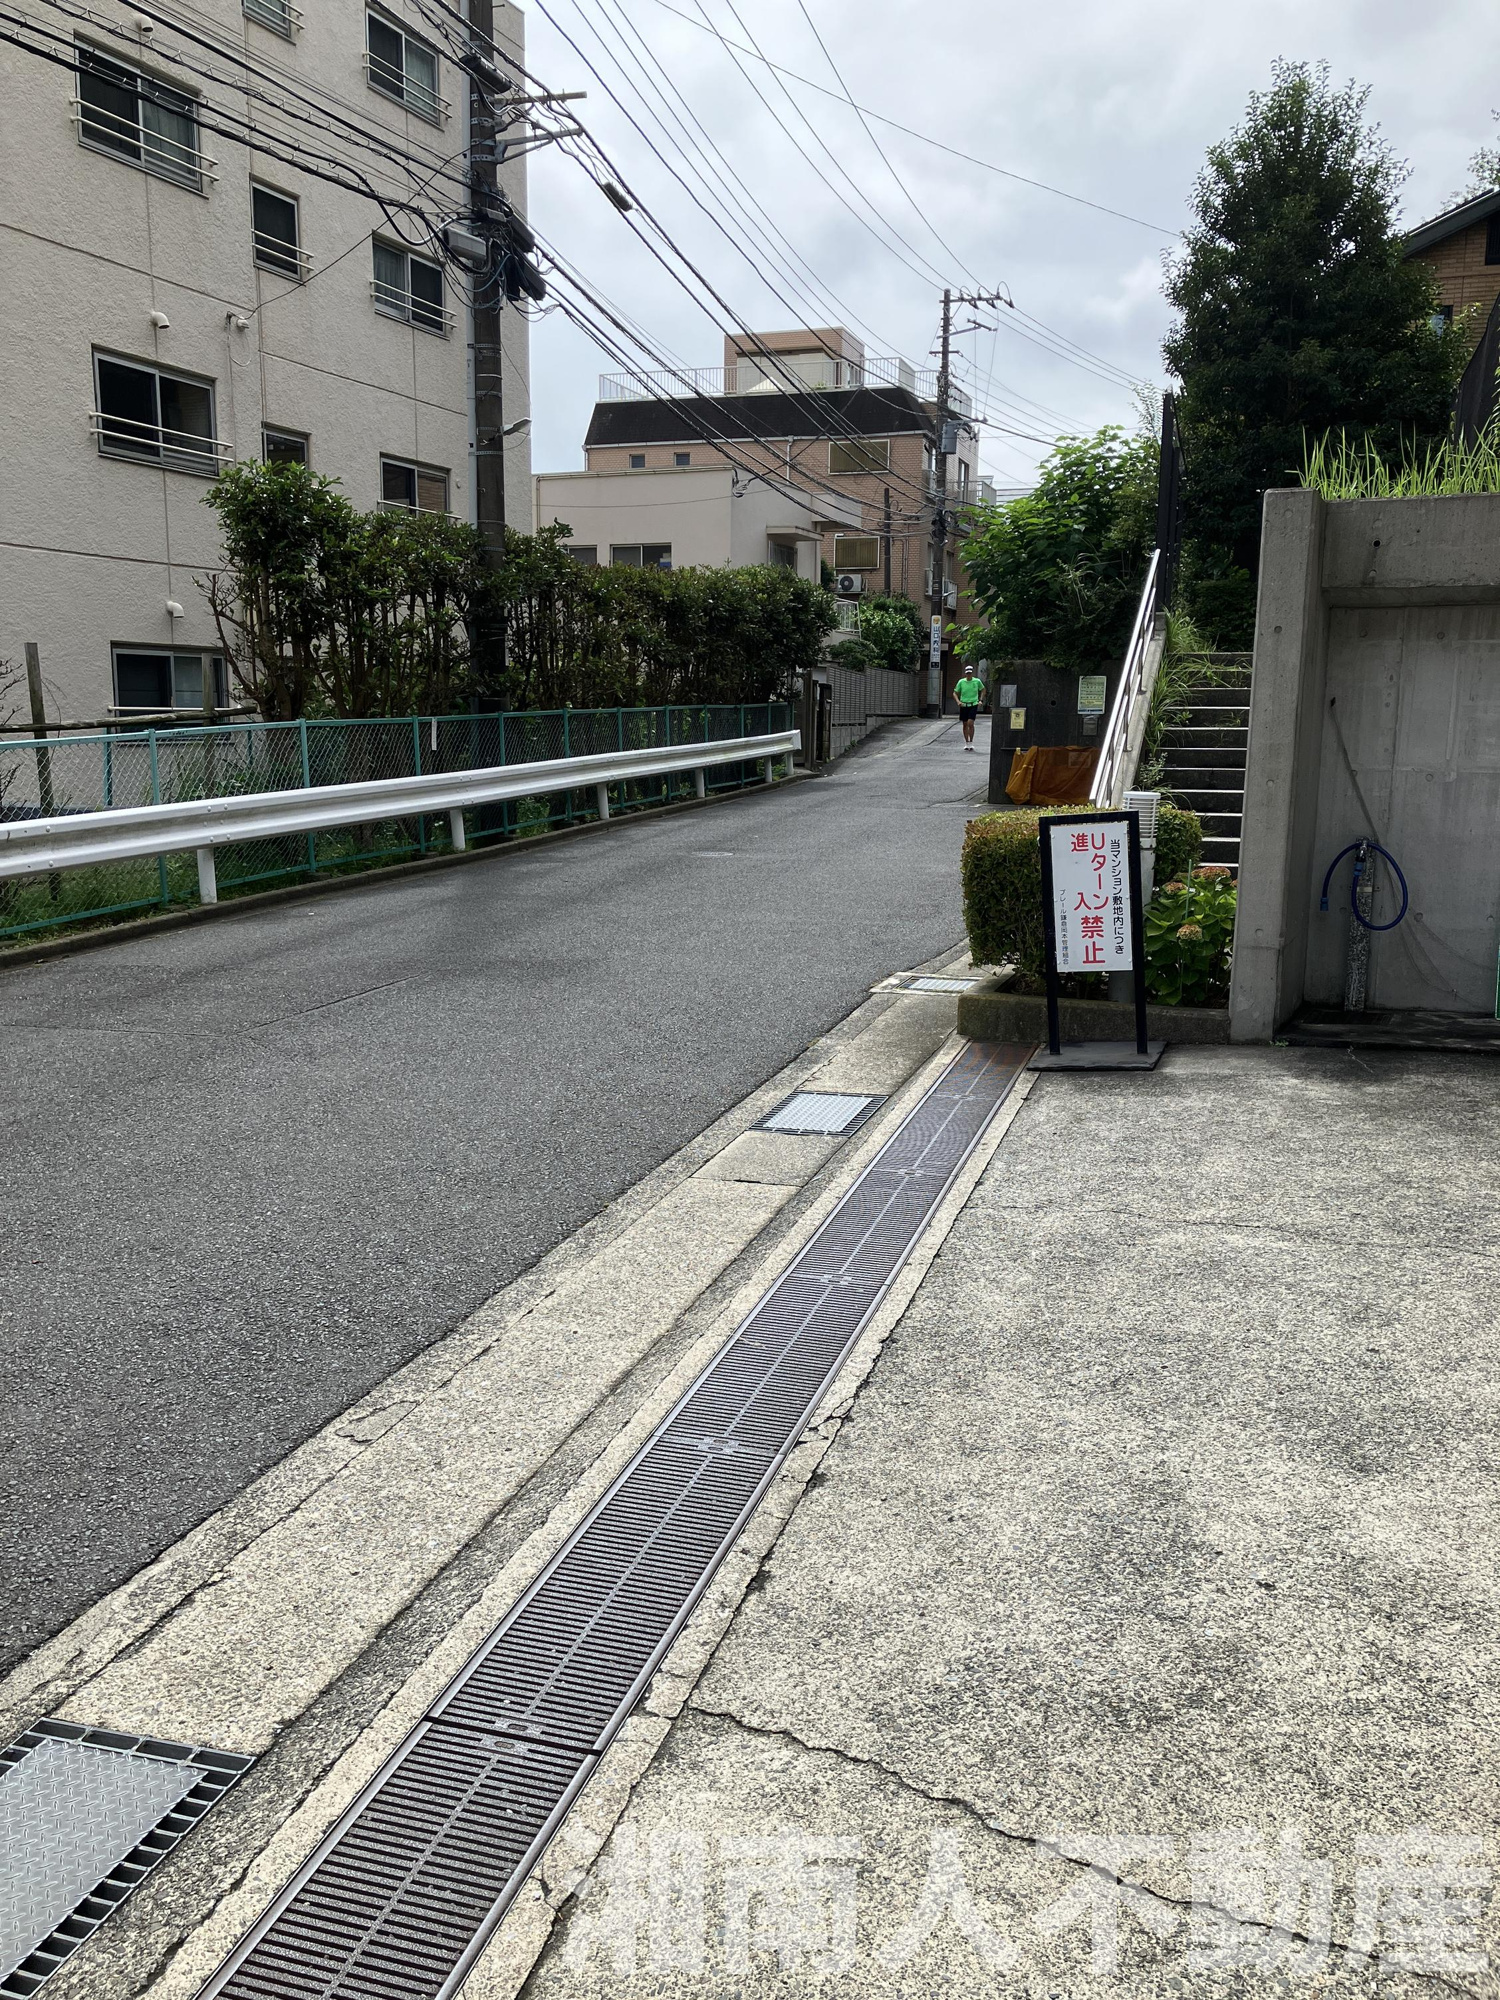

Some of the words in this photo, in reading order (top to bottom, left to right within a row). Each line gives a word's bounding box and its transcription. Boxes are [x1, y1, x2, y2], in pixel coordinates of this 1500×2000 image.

[1091, 832, 1109, 911] Uターン
[1110, 838, 1124, 955] 当マンション敷地内につき
